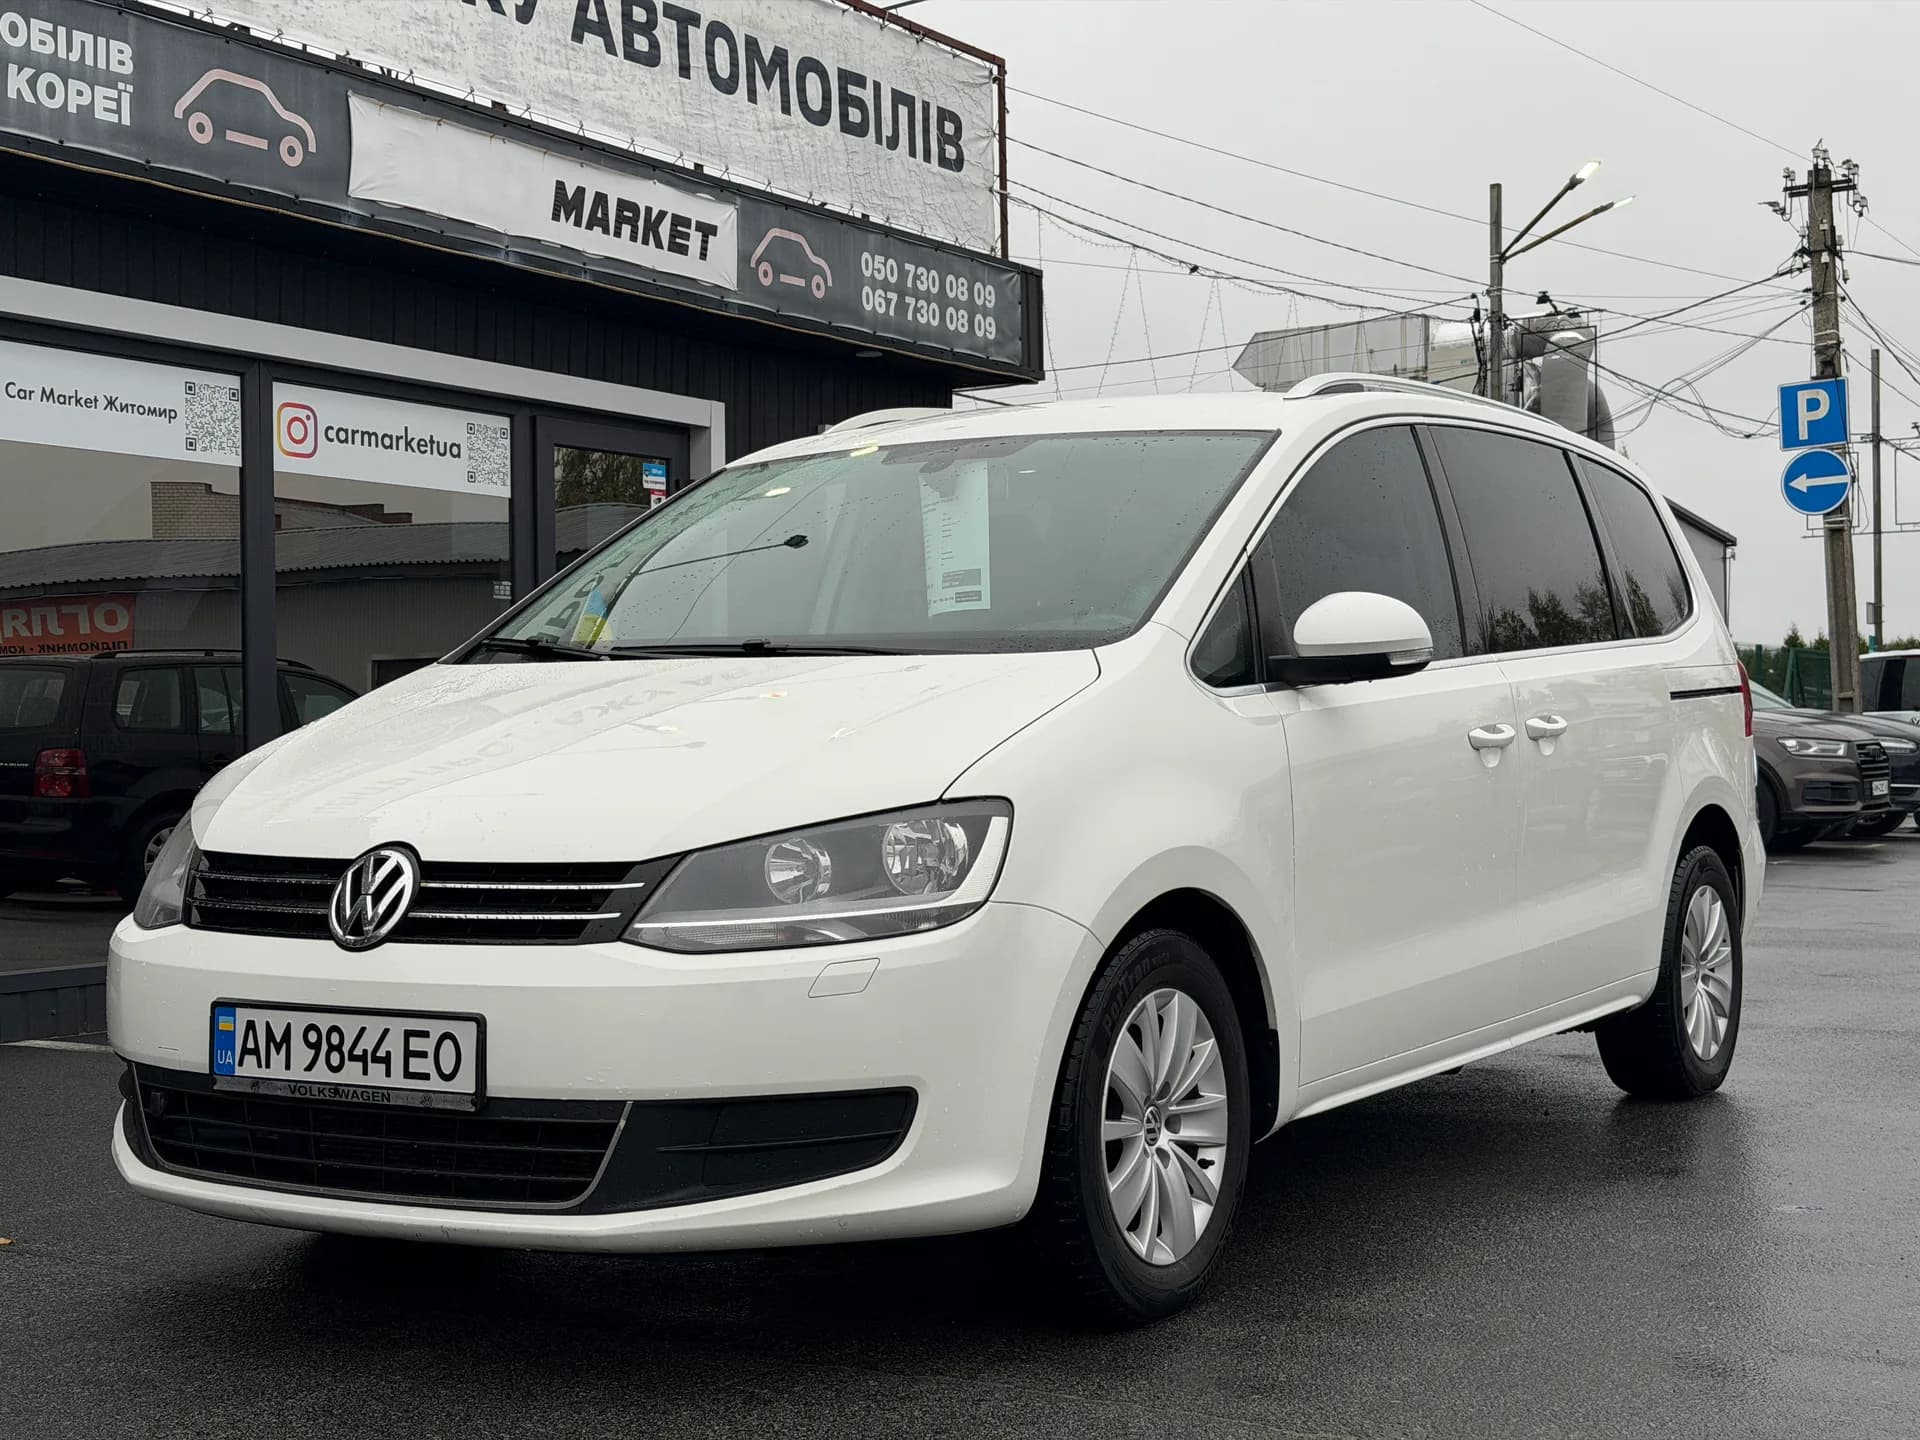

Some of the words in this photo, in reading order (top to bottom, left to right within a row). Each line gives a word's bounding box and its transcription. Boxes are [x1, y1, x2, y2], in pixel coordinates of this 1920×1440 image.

[7, 63, 133, 127] КОРЕЇ
[571, 0, 966, 173] АВТОМОБІЛІВ
[551, 179, 718, 262] MARKET
[861, 252, 898, 283] 050
[904, 263, 939, 294] 730
[945, 274, 968, 301] 08
[974, 282, 996, 308] 09
[862, 286, 898, 316] 067
[905, 296, 940, 326] 730
[946, 307, 969, 333] 08
[974, 314, 996, 340] 09
[5, 382, 36, 401] Car
[40, 386, 99, 409] Market
[104, 395, 178, 424] Житомир
[1797, 388, 1830, 440] P
[324, 423, 462, 459] carmarketua
[217, 1050, 233, 1065] UA
[238, 1019, 291, 1071] AM
[302, 1022, 391, 1078] 9844
[402, 1029, 462, 1082] EO
[287, 1083, 392, 1103] VOLKSWAGEN
